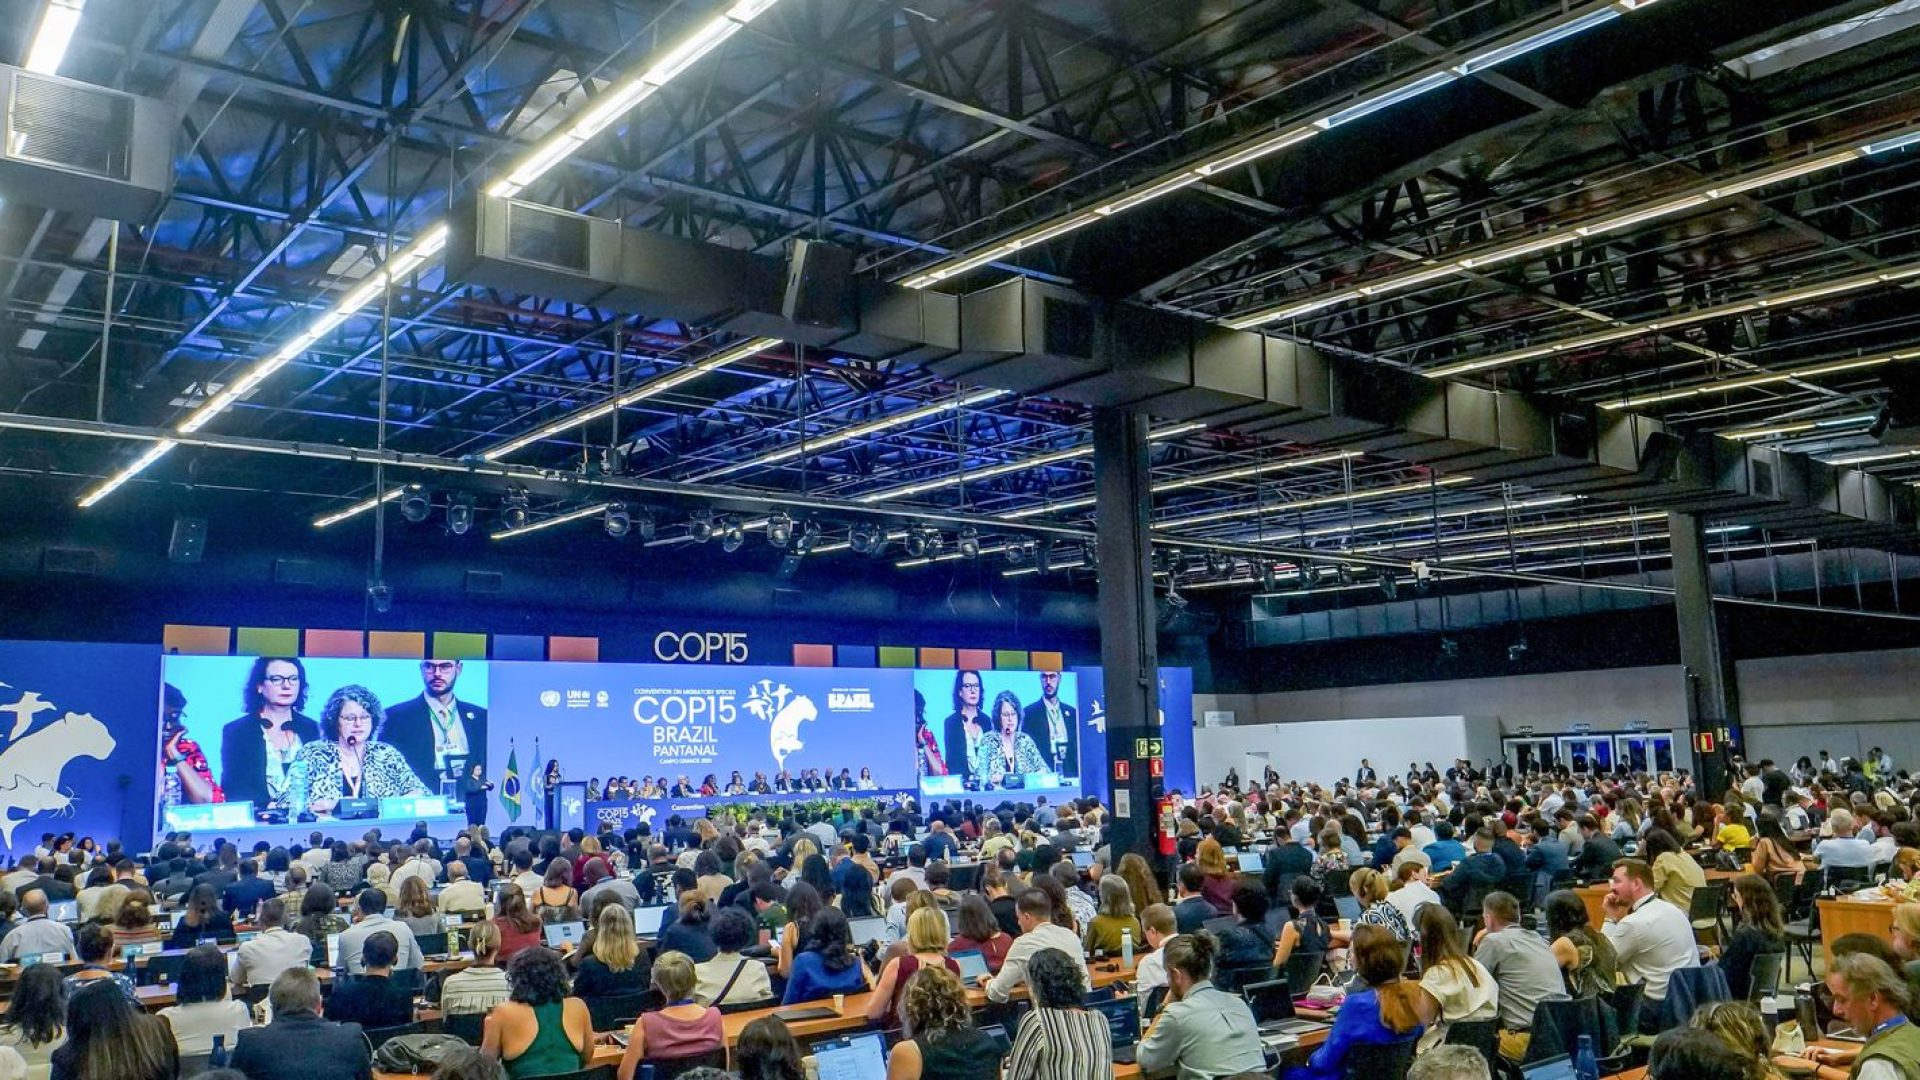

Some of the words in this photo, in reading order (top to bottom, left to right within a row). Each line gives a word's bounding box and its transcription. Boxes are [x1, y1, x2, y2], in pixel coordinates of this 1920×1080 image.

[654, 631, 749, 663] COP15
[633, 696, 737, 724] COP15
[653, 726, 718, 743] BRAZIL
[653, 744, 718, 757] PANTANAL
[597, 809, 628, 820] COP15
